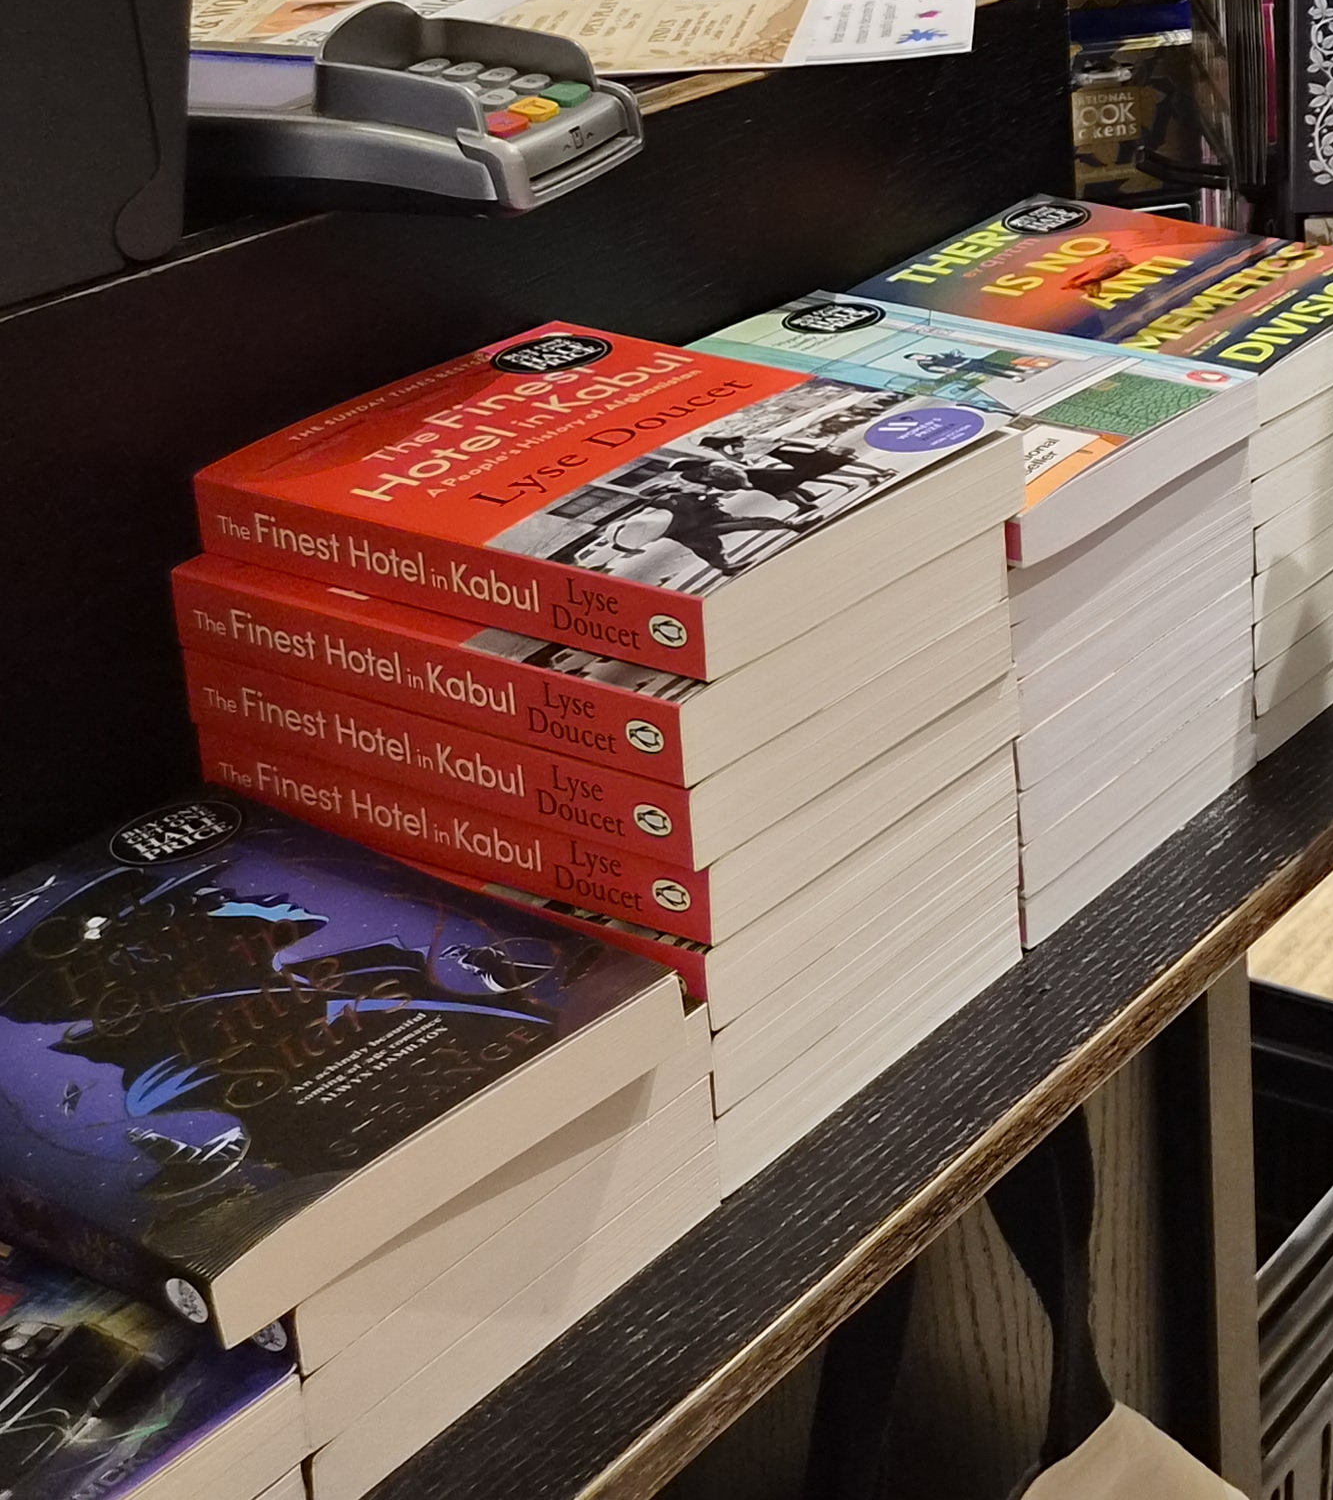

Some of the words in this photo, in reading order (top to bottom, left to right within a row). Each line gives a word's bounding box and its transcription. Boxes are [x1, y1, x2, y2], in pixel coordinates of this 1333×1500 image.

[887, 221, 1019, 284] THER
[981, 273, 1044, 296] IS
[1025, 237, 1111, 273] NO
[1082, 256, 1194, 310] ANTI
[288, 423, 325, 442] THE
[325, 397, 386, 426] SUNDAY
[388, 377, 436, 399] TIMES
[531, 351, 695, 413] Kabul
[362, 432, 440, 461] The
[423, 366, 595, 429] Finest
[427, 488, 447, 498] A
[441, 446, 521, 487] People's
[517, 417, 586, 450] History
[586, 408, 605, 420] of
[604, 369, 703, 411] Afghanistan
[511, 414, 554, 429] in
[350, 425, 518, 502] Hotel
[469, 453, 589, 507] Lyse
[582, 380, 753, 449] Doucet
[217, 515, 251, 540] The
[254, 512, 340, 563] Finest
[348, 536, 427, 585] Hotel
[431, 567, 448, 588] in
[451, 562, 540, 612] Kabul
[565, 578, 618, 615] Lyse
[552, 605, 641, 650] Doucet
[194, 609, 227, 637] The
[230, 609, 316, 660] Finest
[325, 634, 402, 684] Hotel
[407, 667, 423, 689] in
[426, 662, 517, 716] Kabul
[543, 682, 595, 719] Lyse
[204, 687, 237, 714] The
[241, 688, 326, 739] Finest
[336, 713, 411, 765] Hotel
[417, 748, 433, 770] in
[436, 744, 525, 797] Kabul
[528, 708, 617, 754] Doucet
[552, 764, 603, 802] Lyse
[132, 814, 217, 853] HALF
[142, 821, 233, 860] PRICE
[219, 762, 252, 788] The
[256, 762, 342, 813] Finest
[352, 789, 428, 840] Hotel
[433, 824, 450, 844] in
[454, 819, 542, 872] Kabul
[537, 791, 626, 837] Doucet
[570, 840, 622, 877] Lyse
[555, 867, 643, 912] Doucet
[315, 1048, 369, 1081] achingly
[368, 1012, 427, 1048] beautiful
[320, 1072, 373, 1104] ALWYN
[376, 1025, 449, 1071] HAMILTON
[296, 1074, 346, 1105] coming
[347, 1062, 362, 1074] of
[363, 1049, 388, 1066] age
